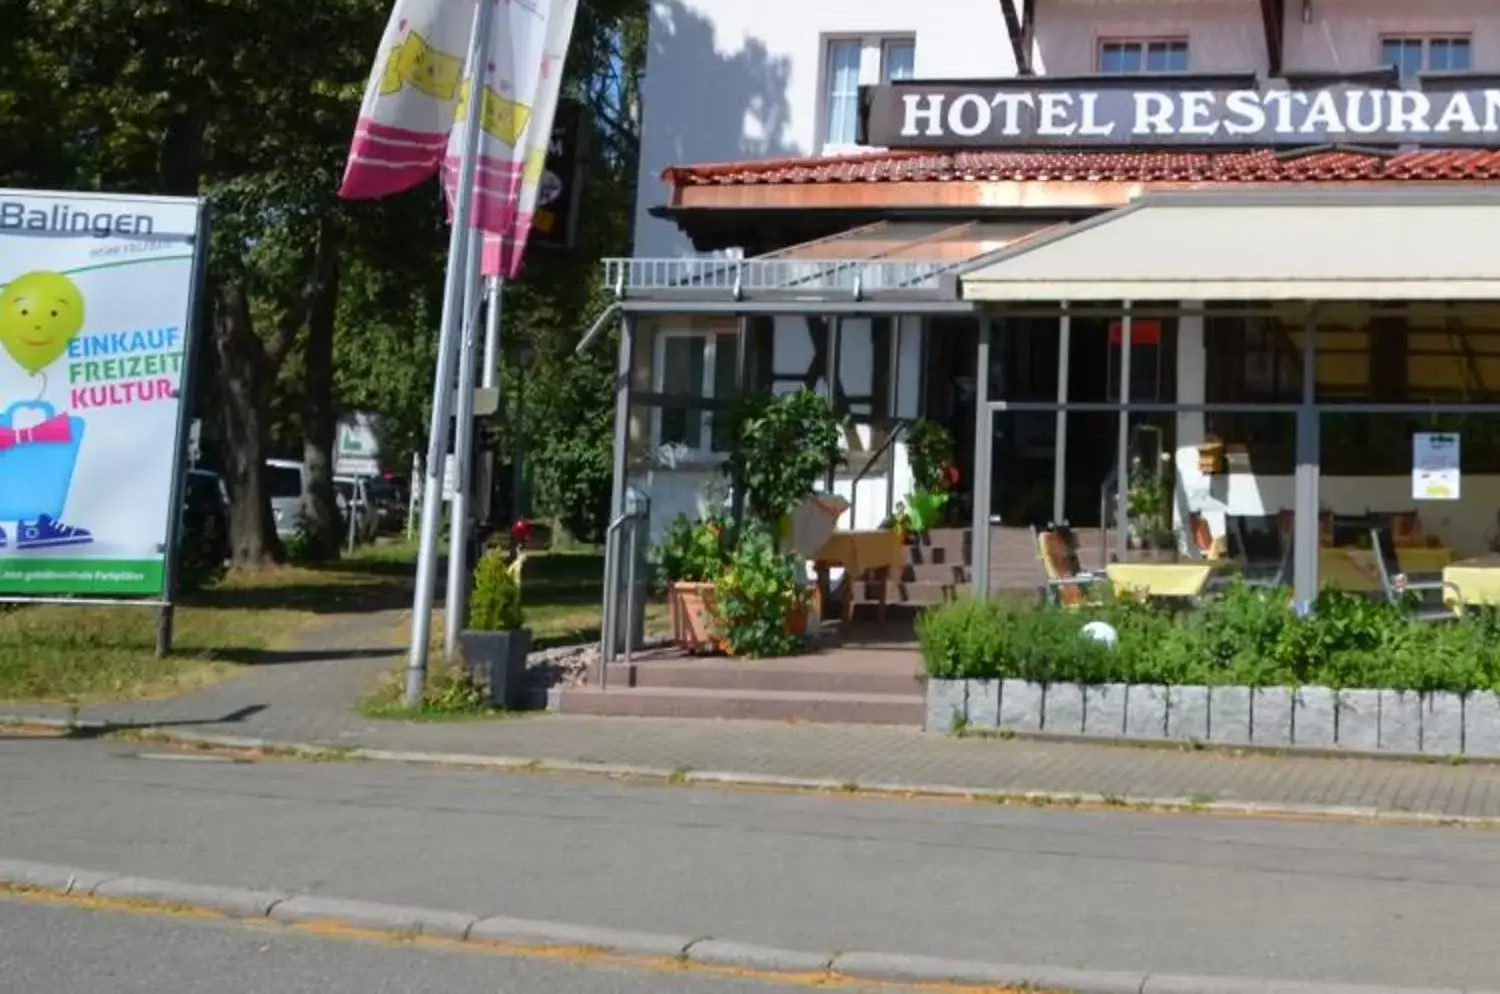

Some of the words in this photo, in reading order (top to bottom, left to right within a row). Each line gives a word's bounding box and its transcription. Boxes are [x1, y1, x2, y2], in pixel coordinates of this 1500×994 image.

[901, 92, 1116, 137] HOTEL
[0, 202, 154, 238] Balingen
[67, 326, 179, 358] EINKAUF
[69, 351, 184, 385] FREIZEIT
[71, 378, 173, 409] KULTUR
